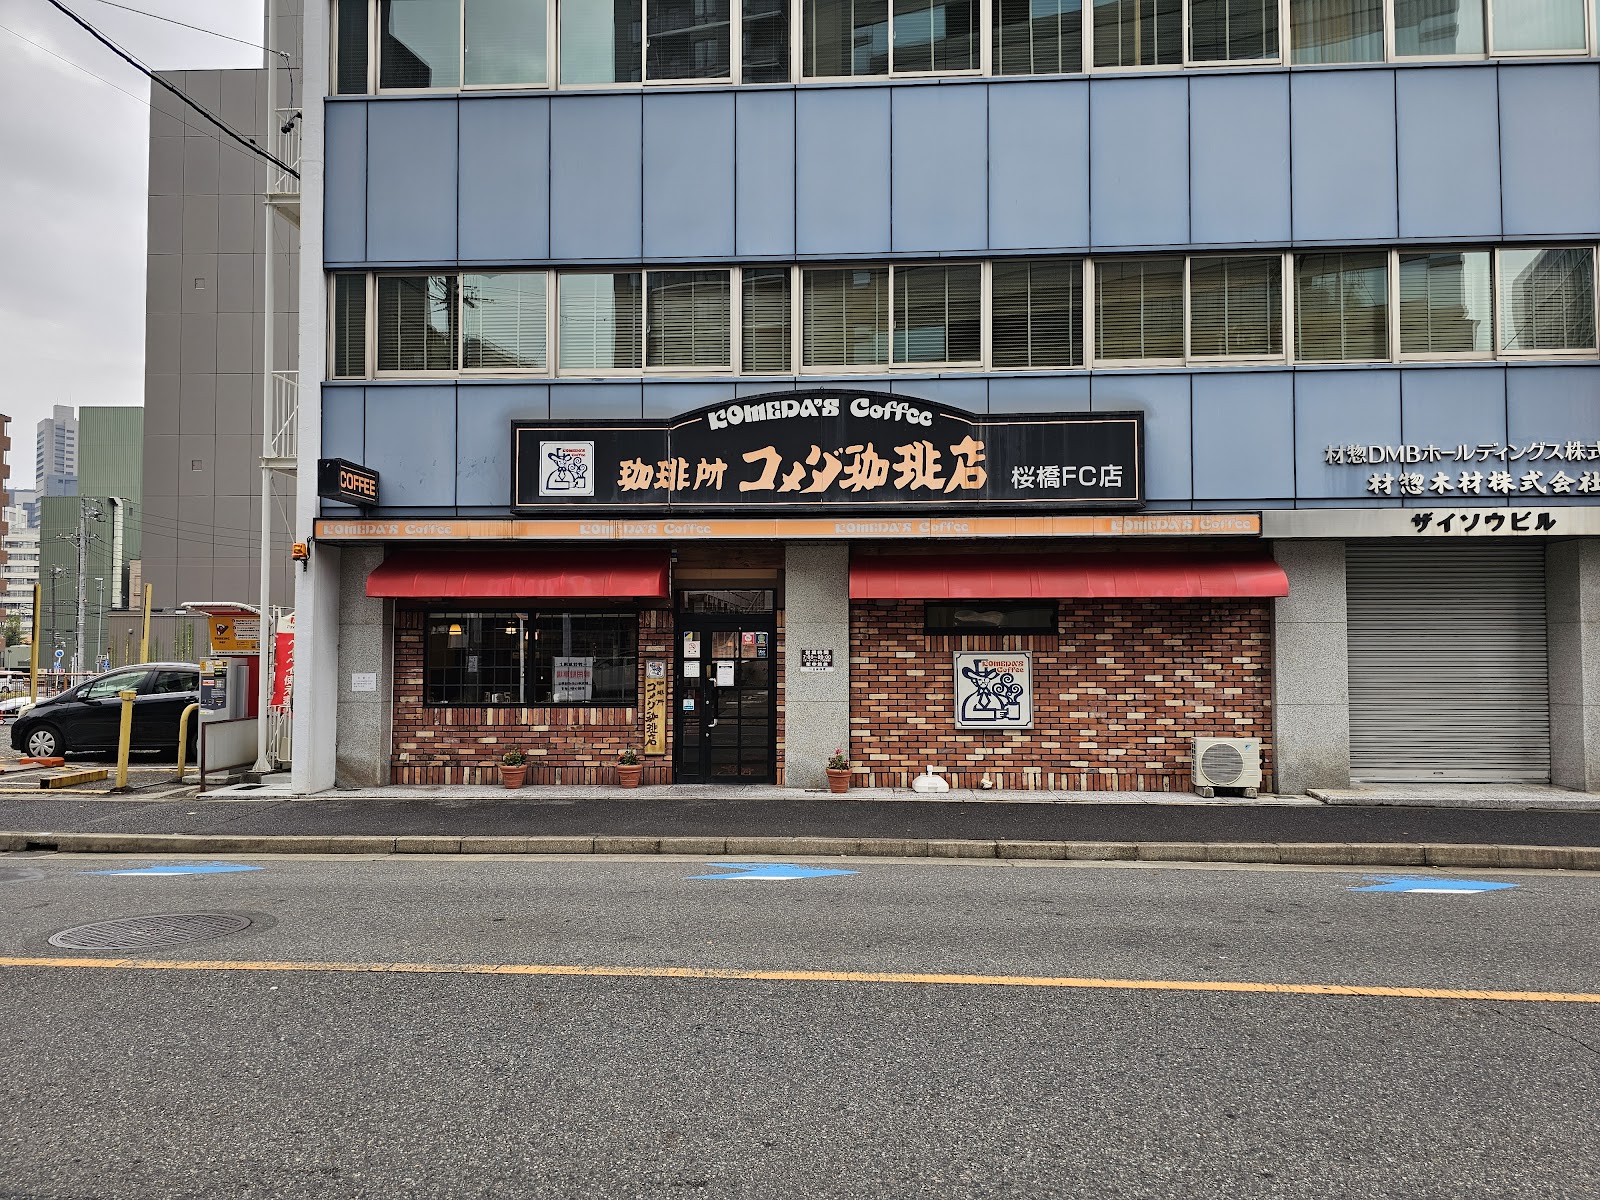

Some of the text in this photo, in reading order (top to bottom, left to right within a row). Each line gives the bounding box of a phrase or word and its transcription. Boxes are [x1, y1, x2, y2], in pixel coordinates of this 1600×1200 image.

[707, 398, 933, 430] KOMEDA'S Coffee
[617, 435, 988, 493] 珈琲所 コメダ珈琲店
[340, 470, 376, 497] COFFEE
[1011, 464, 1124, 490] 桜橋FC店
[404, 523, 452, 535] Coffee
[663, 523, 711, 535] Coffee
[918, 521, 969, 534] Coffee
[1199, 517, 1252, 531] Coffee
[1410, 511, 1557, 533] ザイソウビル
